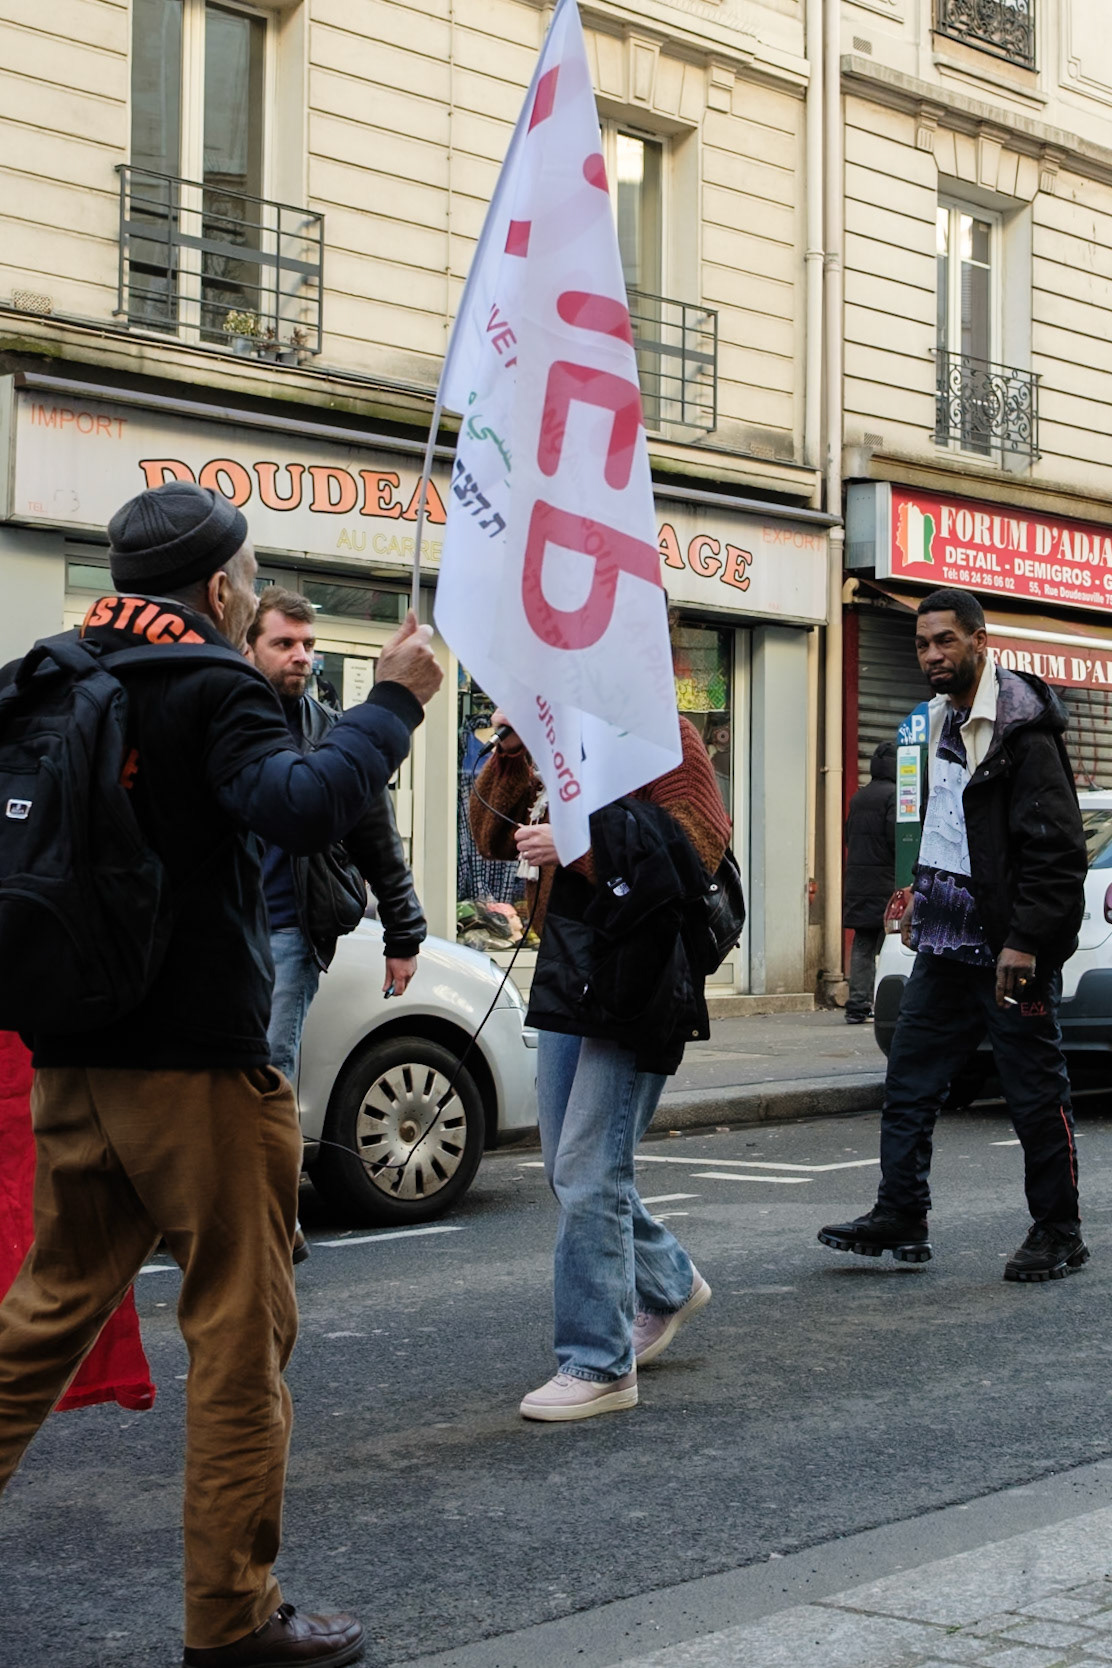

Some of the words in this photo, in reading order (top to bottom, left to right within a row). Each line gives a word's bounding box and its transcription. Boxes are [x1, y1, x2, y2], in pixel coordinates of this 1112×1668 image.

[31, 403, 128, 440] IMPORT
[337, 527, 367, 552] AU
[762, 526, 826, 551] EXPORT
[939, 505, 1029, 553] FORUM
[945, 546, 1001, 572] DETAIL
[1014, 558, 1092, 588] DEMIGROS
[971, 571, 981, 584] 24
[1005, 577, 1015, 589] 02
[1044, 583, 1058, 597] Rue
[80, 596, 206, 644] STIC
[986, 647, 1067, 680] FORUM
[911, 714, 926, 743] P
